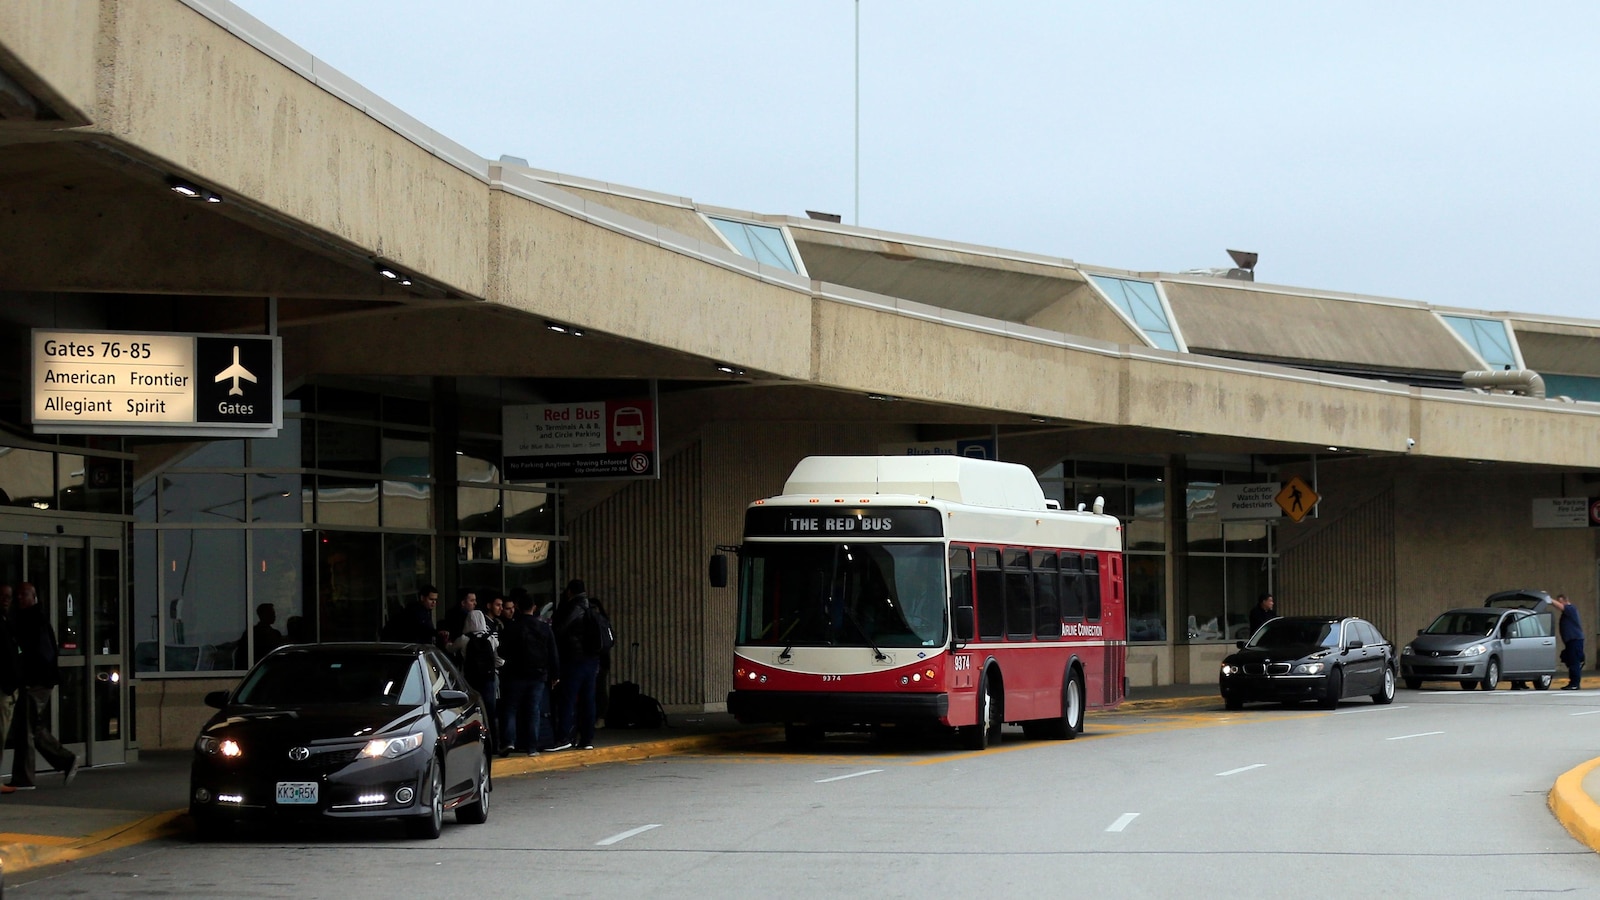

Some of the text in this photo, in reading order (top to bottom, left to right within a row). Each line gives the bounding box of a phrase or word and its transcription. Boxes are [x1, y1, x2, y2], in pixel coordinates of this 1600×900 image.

[44, 340, 151, 359] Gates 76-85
[44, 370, 189, 387] American Frontier
[44, 397, 166, 416] Allegiant Spirit
[218, 402, 254, 415] Gates
[544, 408, 600, 421] Red Bus
[545, 423, 576, 431] Terminals
[576, 430, 601, 438] Parking
[907, 447, 953, 456] Blue Bus
[545, 461, 571, 469] Anytime
[1232, 501, 1273, 509] Pedestrians
[790, 518, 892, 530] THE RED BUS
[954, 655, 970, 670] 9374
